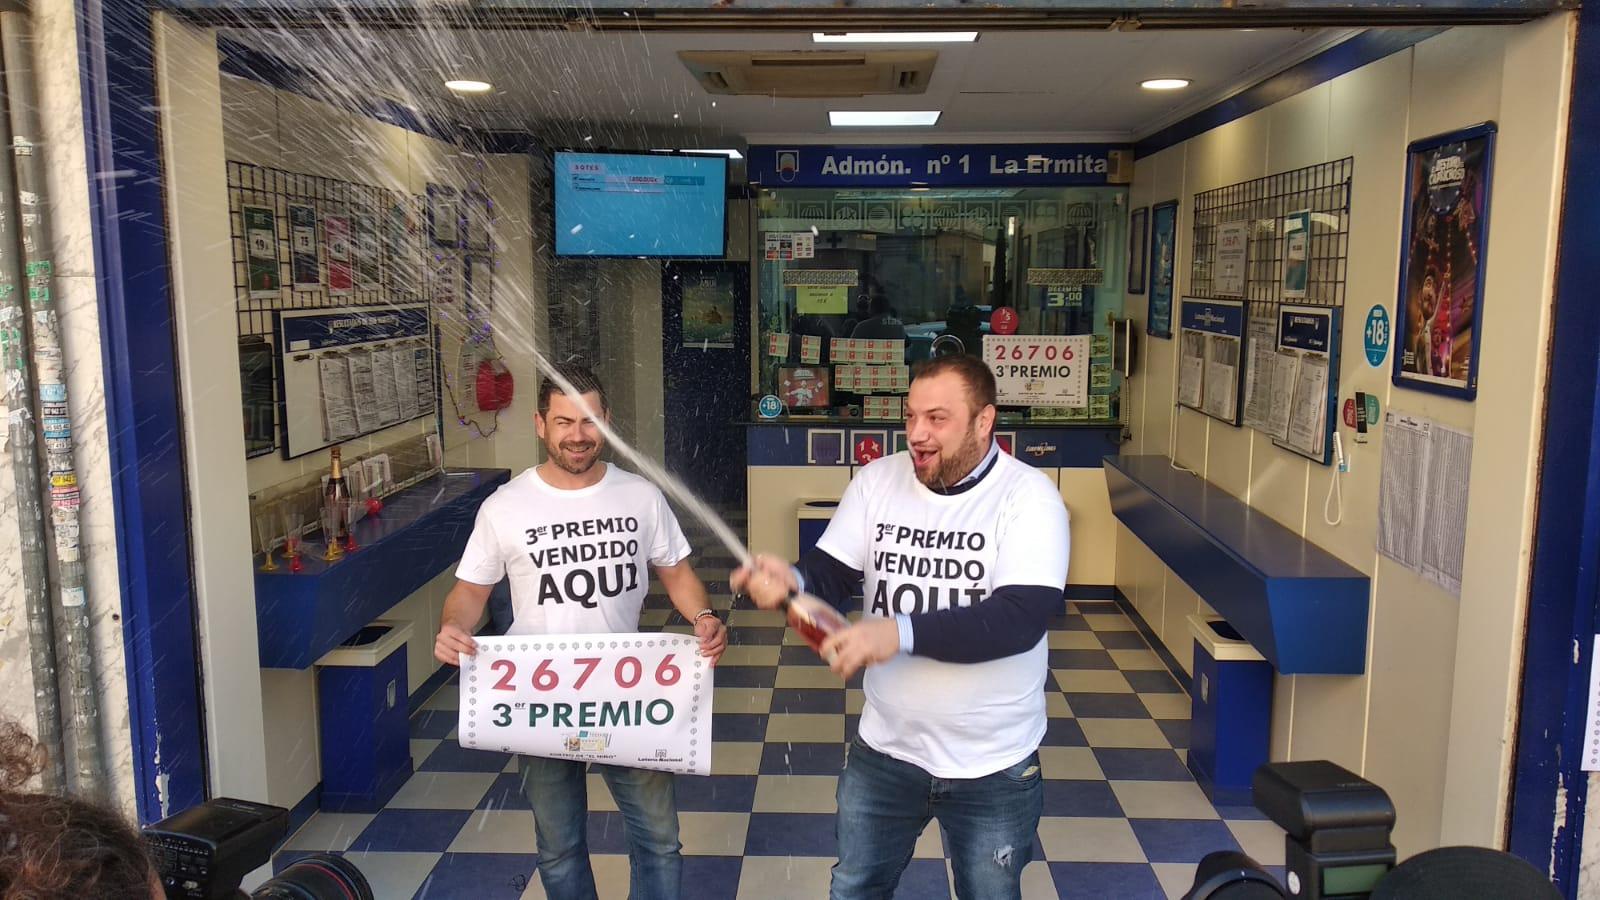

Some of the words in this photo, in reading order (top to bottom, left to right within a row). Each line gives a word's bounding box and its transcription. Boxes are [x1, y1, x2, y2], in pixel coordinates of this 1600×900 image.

[821, 154, 911, 175] Admón.
[927, 154, 951, 174] nº
[959, 154, 970, 174] 1
[990, 154, 1018, 174] La
[1027, 154, 1108, 174] Ermita
[995, 344, 1074, 361] 26706
[1010, 365, 1071, 378] PREMIO
[551, 516, 638, 540] PREMIO
[896, 525, 986, 551] PREMIO
[529, 539, 638, 569] VENDIDO
[874, 550, 986, 581] VENDIDO
[490, 653, 682, 692] 26706
[528, 698, 675, 729] PREMIO
